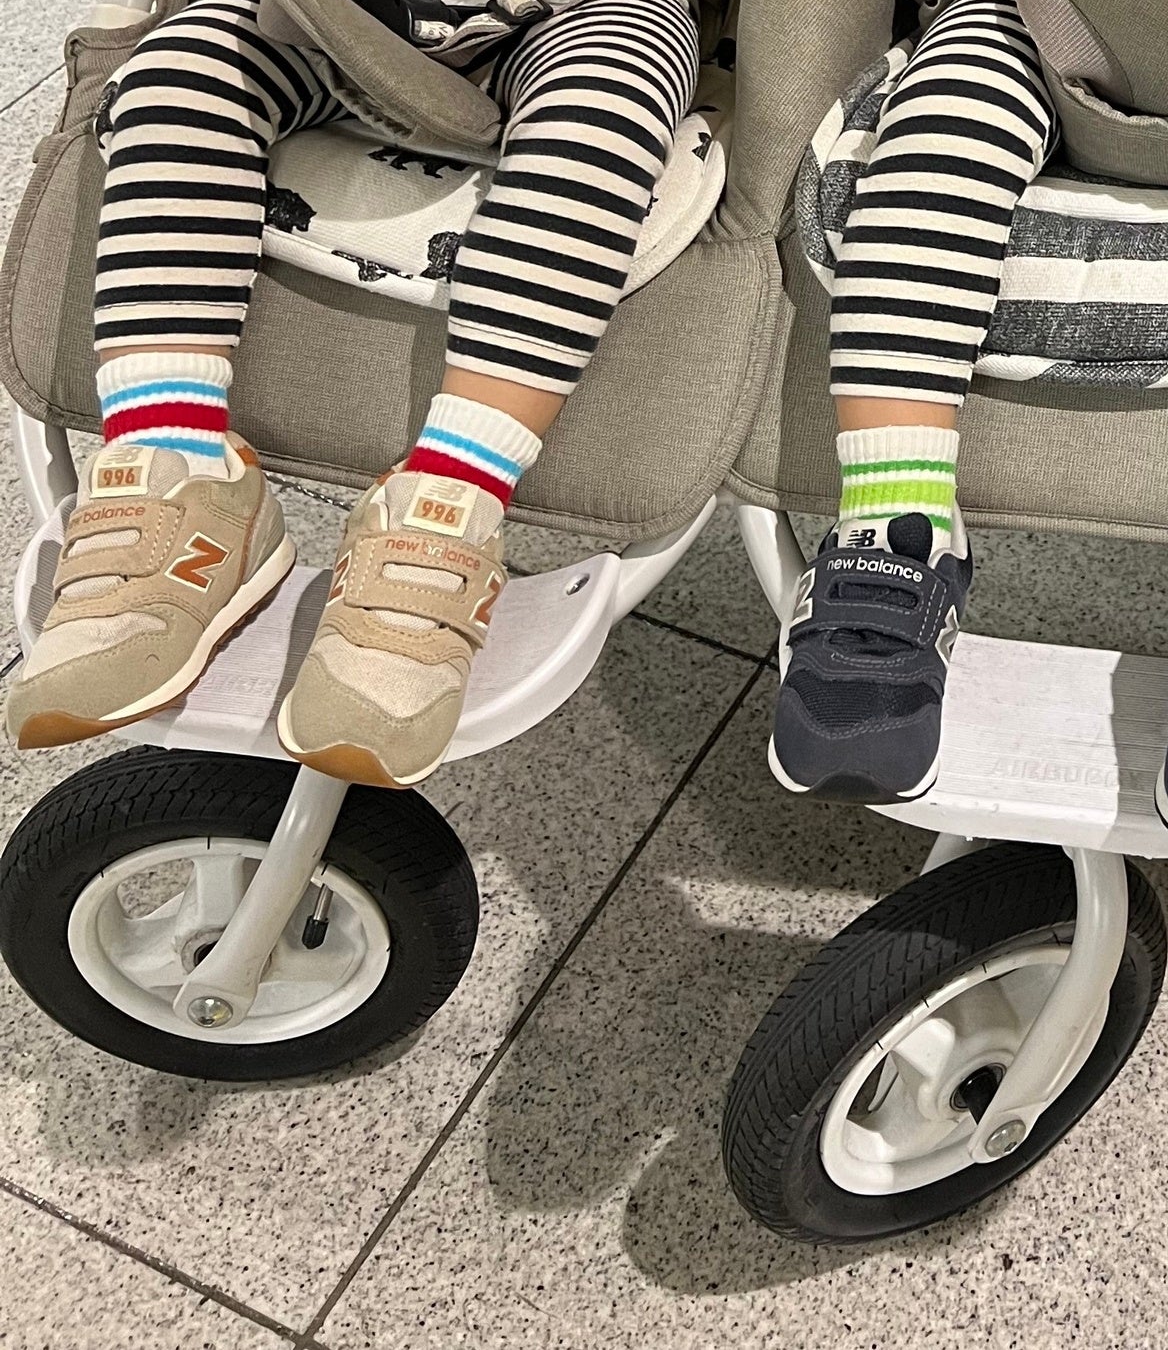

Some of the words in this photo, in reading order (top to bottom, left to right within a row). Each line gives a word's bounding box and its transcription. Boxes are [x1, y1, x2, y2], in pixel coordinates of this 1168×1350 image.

[103, 467, 135, 486] 996
[82, 506, 146, 524] balance
[421, 500, 457, 525] 996
[385, 537, 420, 552] new
[422, 541, 481, 571] balance
[826, 556, 855, 570] new
[856, 556, 924, 583] balance
